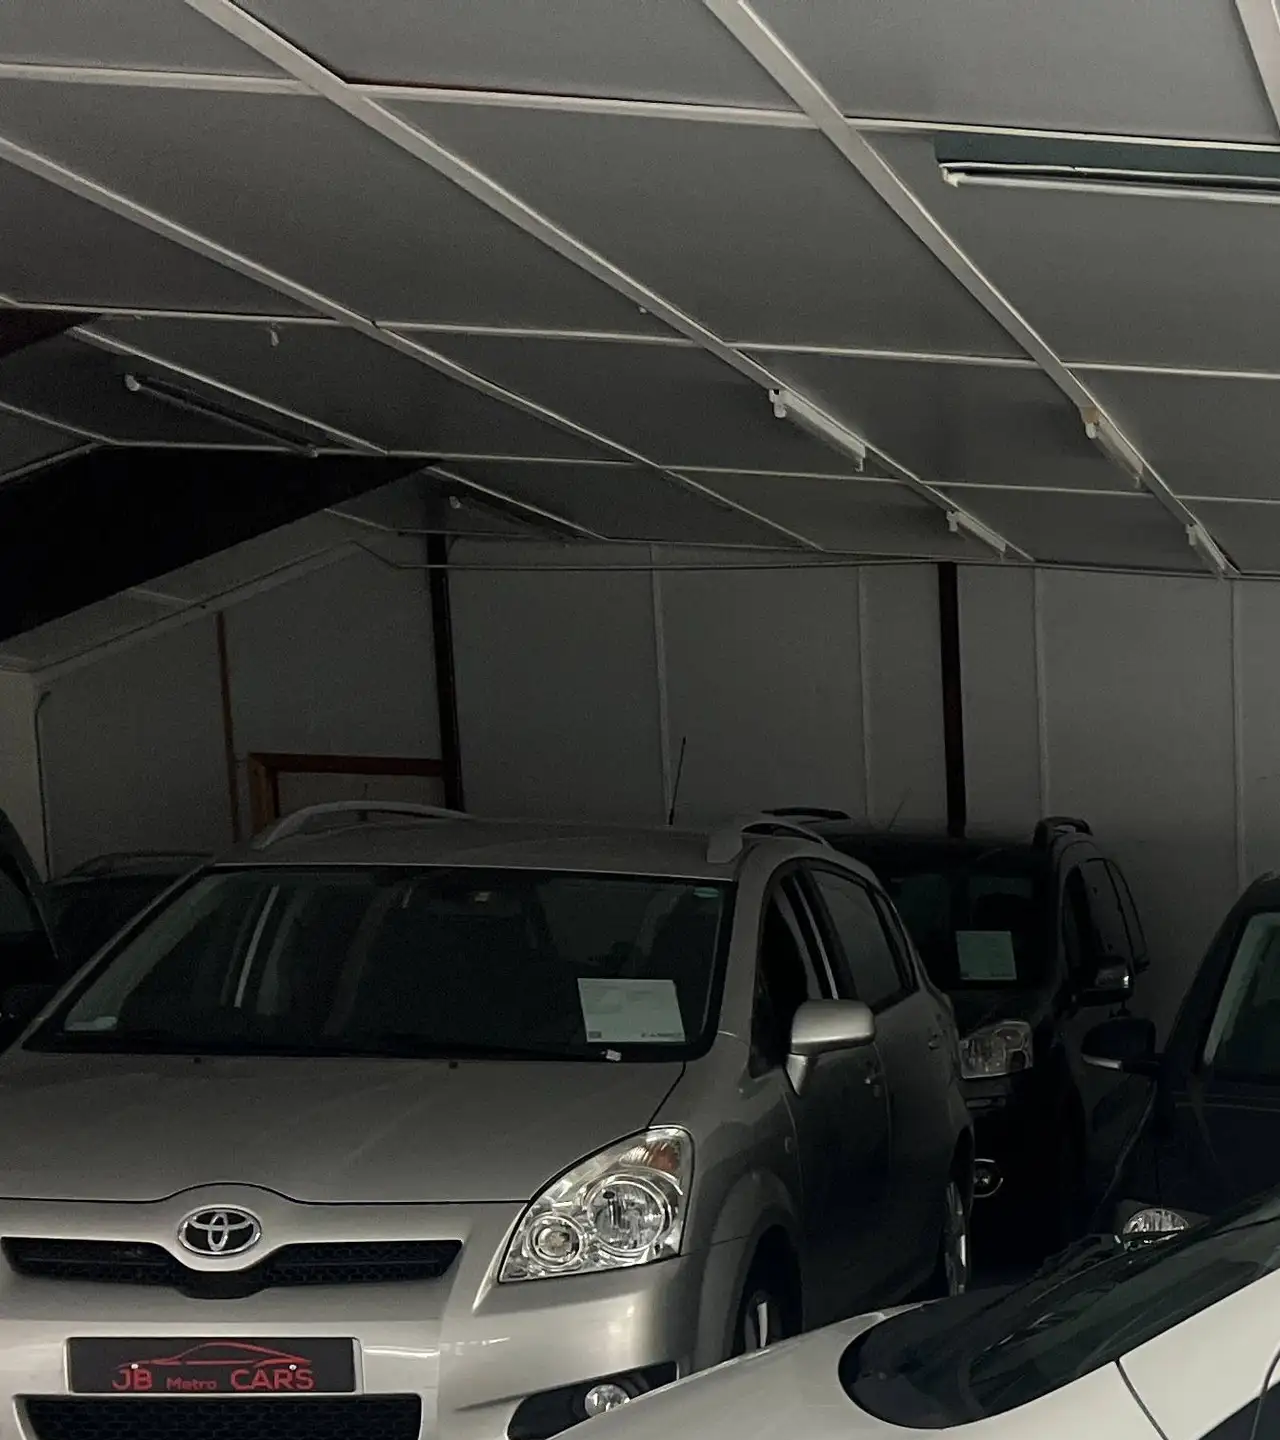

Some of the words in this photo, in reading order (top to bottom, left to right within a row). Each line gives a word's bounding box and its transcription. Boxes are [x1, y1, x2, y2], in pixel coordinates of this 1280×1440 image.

[112, 1369, 153, 1391] JB
[166, 1377, 217, 1391] Metro
[230, 1369, 315, 1391] CARS
